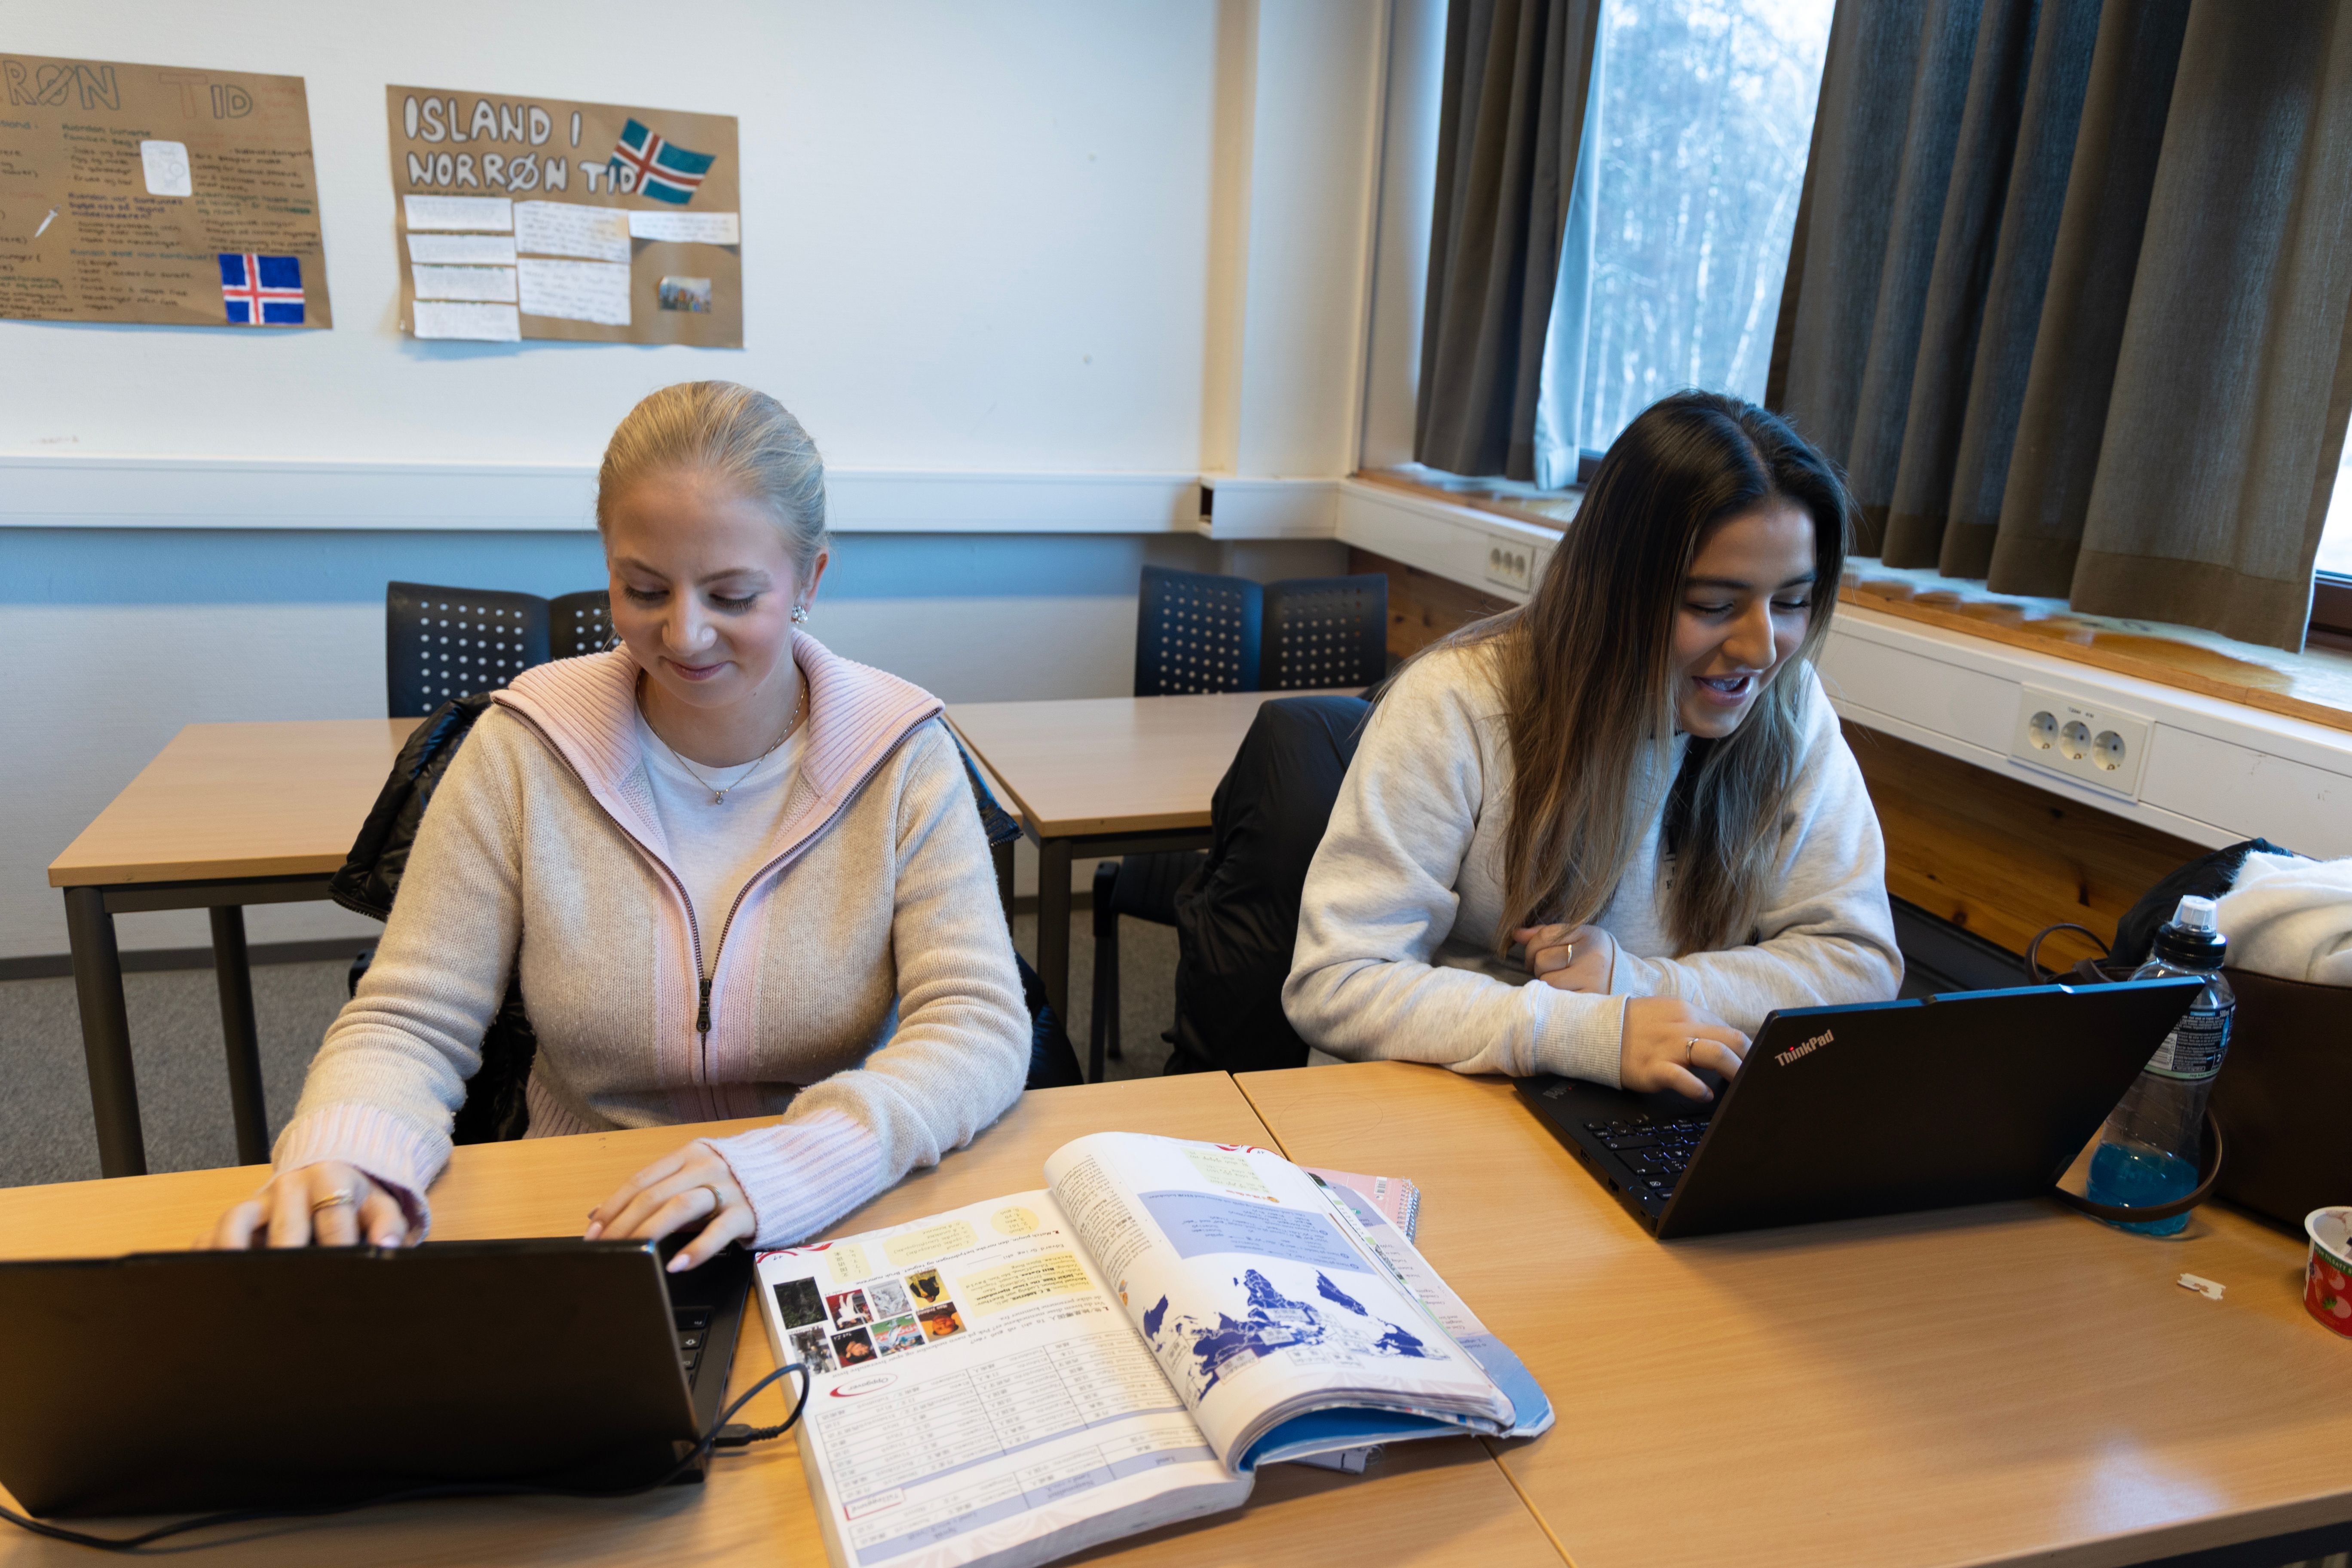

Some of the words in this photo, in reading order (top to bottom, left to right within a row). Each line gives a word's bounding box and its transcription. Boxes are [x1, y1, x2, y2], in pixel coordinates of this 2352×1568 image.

[159, 73, 253, 119] TID
[404, 95, 551, 146] ISLAND
[570, 111, 582, 147] I
[407, 151, 568, 192] NORRØN
[579, 161, 637, 194] TID
[1774, 1029, 1834, 1066] ThinkPad
[935, 1250, 974, 1263] betydningen
[2325, 1253, 2346, 1271] TILSATT
[904, 1264, 925, 1273] tegnet.
[855, 1276, 883, 1285] numrene.
[1012, 1291, 1037, 1301] Andersen,
[916, 1341, 947, 1353] nedenfor
[850, 1359, 887, 1373] hverandre
[848, 1377, 888, 1391] Oppgaver
